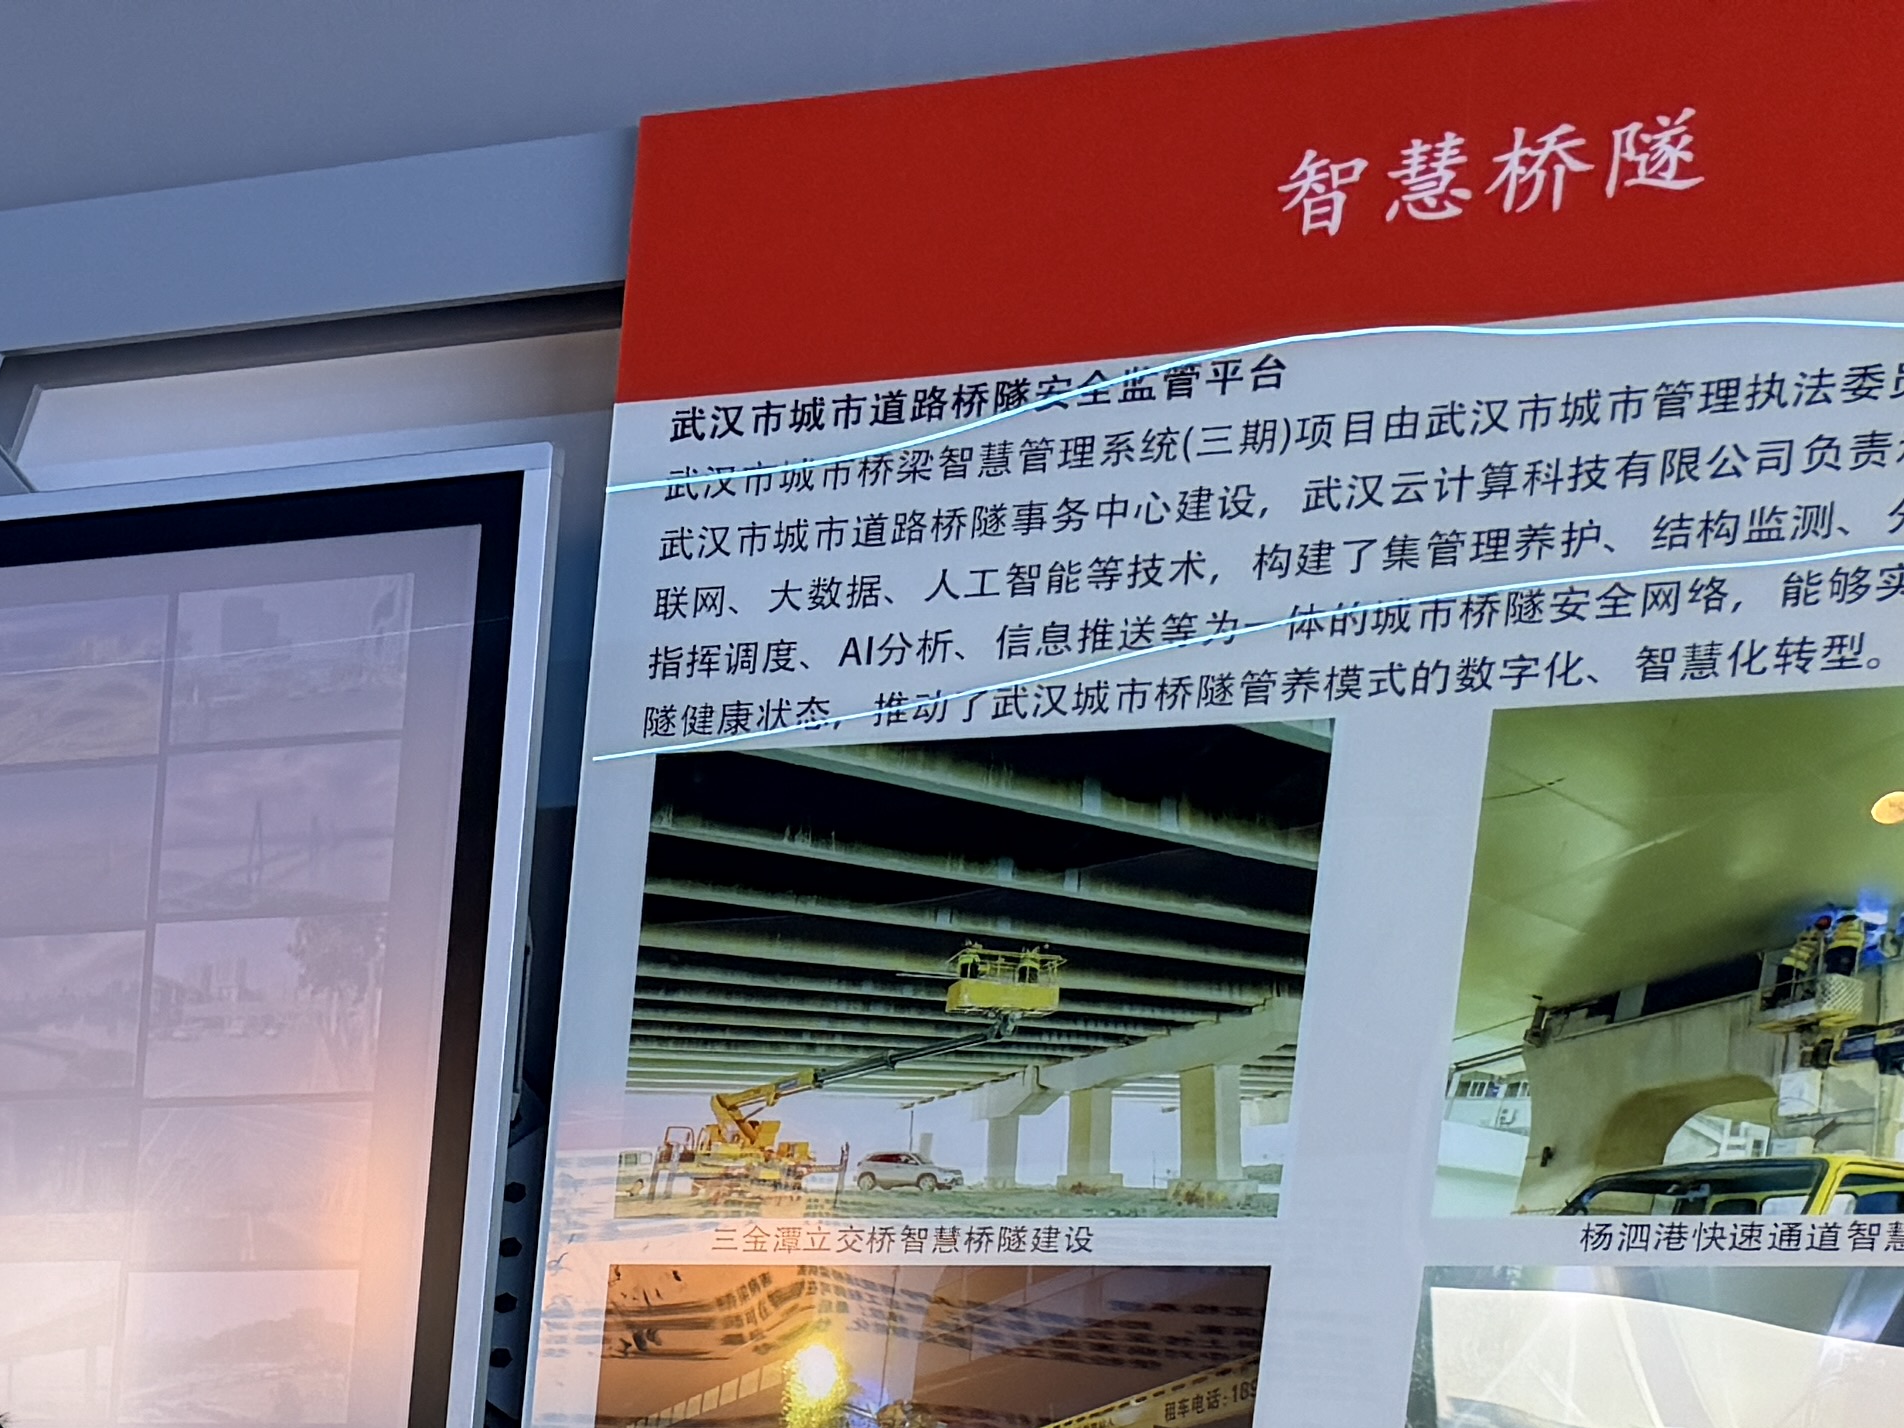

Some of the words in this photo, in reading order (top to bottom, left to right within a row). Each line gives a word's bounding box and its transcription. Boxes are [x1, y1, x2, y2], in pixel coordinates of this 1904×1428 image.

[1277, 107, 1705, 237] 智慧桥隧
[669, 353, 1287, 443] 武汉市城市道路桥隧安全监管平台
[711, 1224, 1094, 1254] 三金潭立交桥智慧桥隧建设
